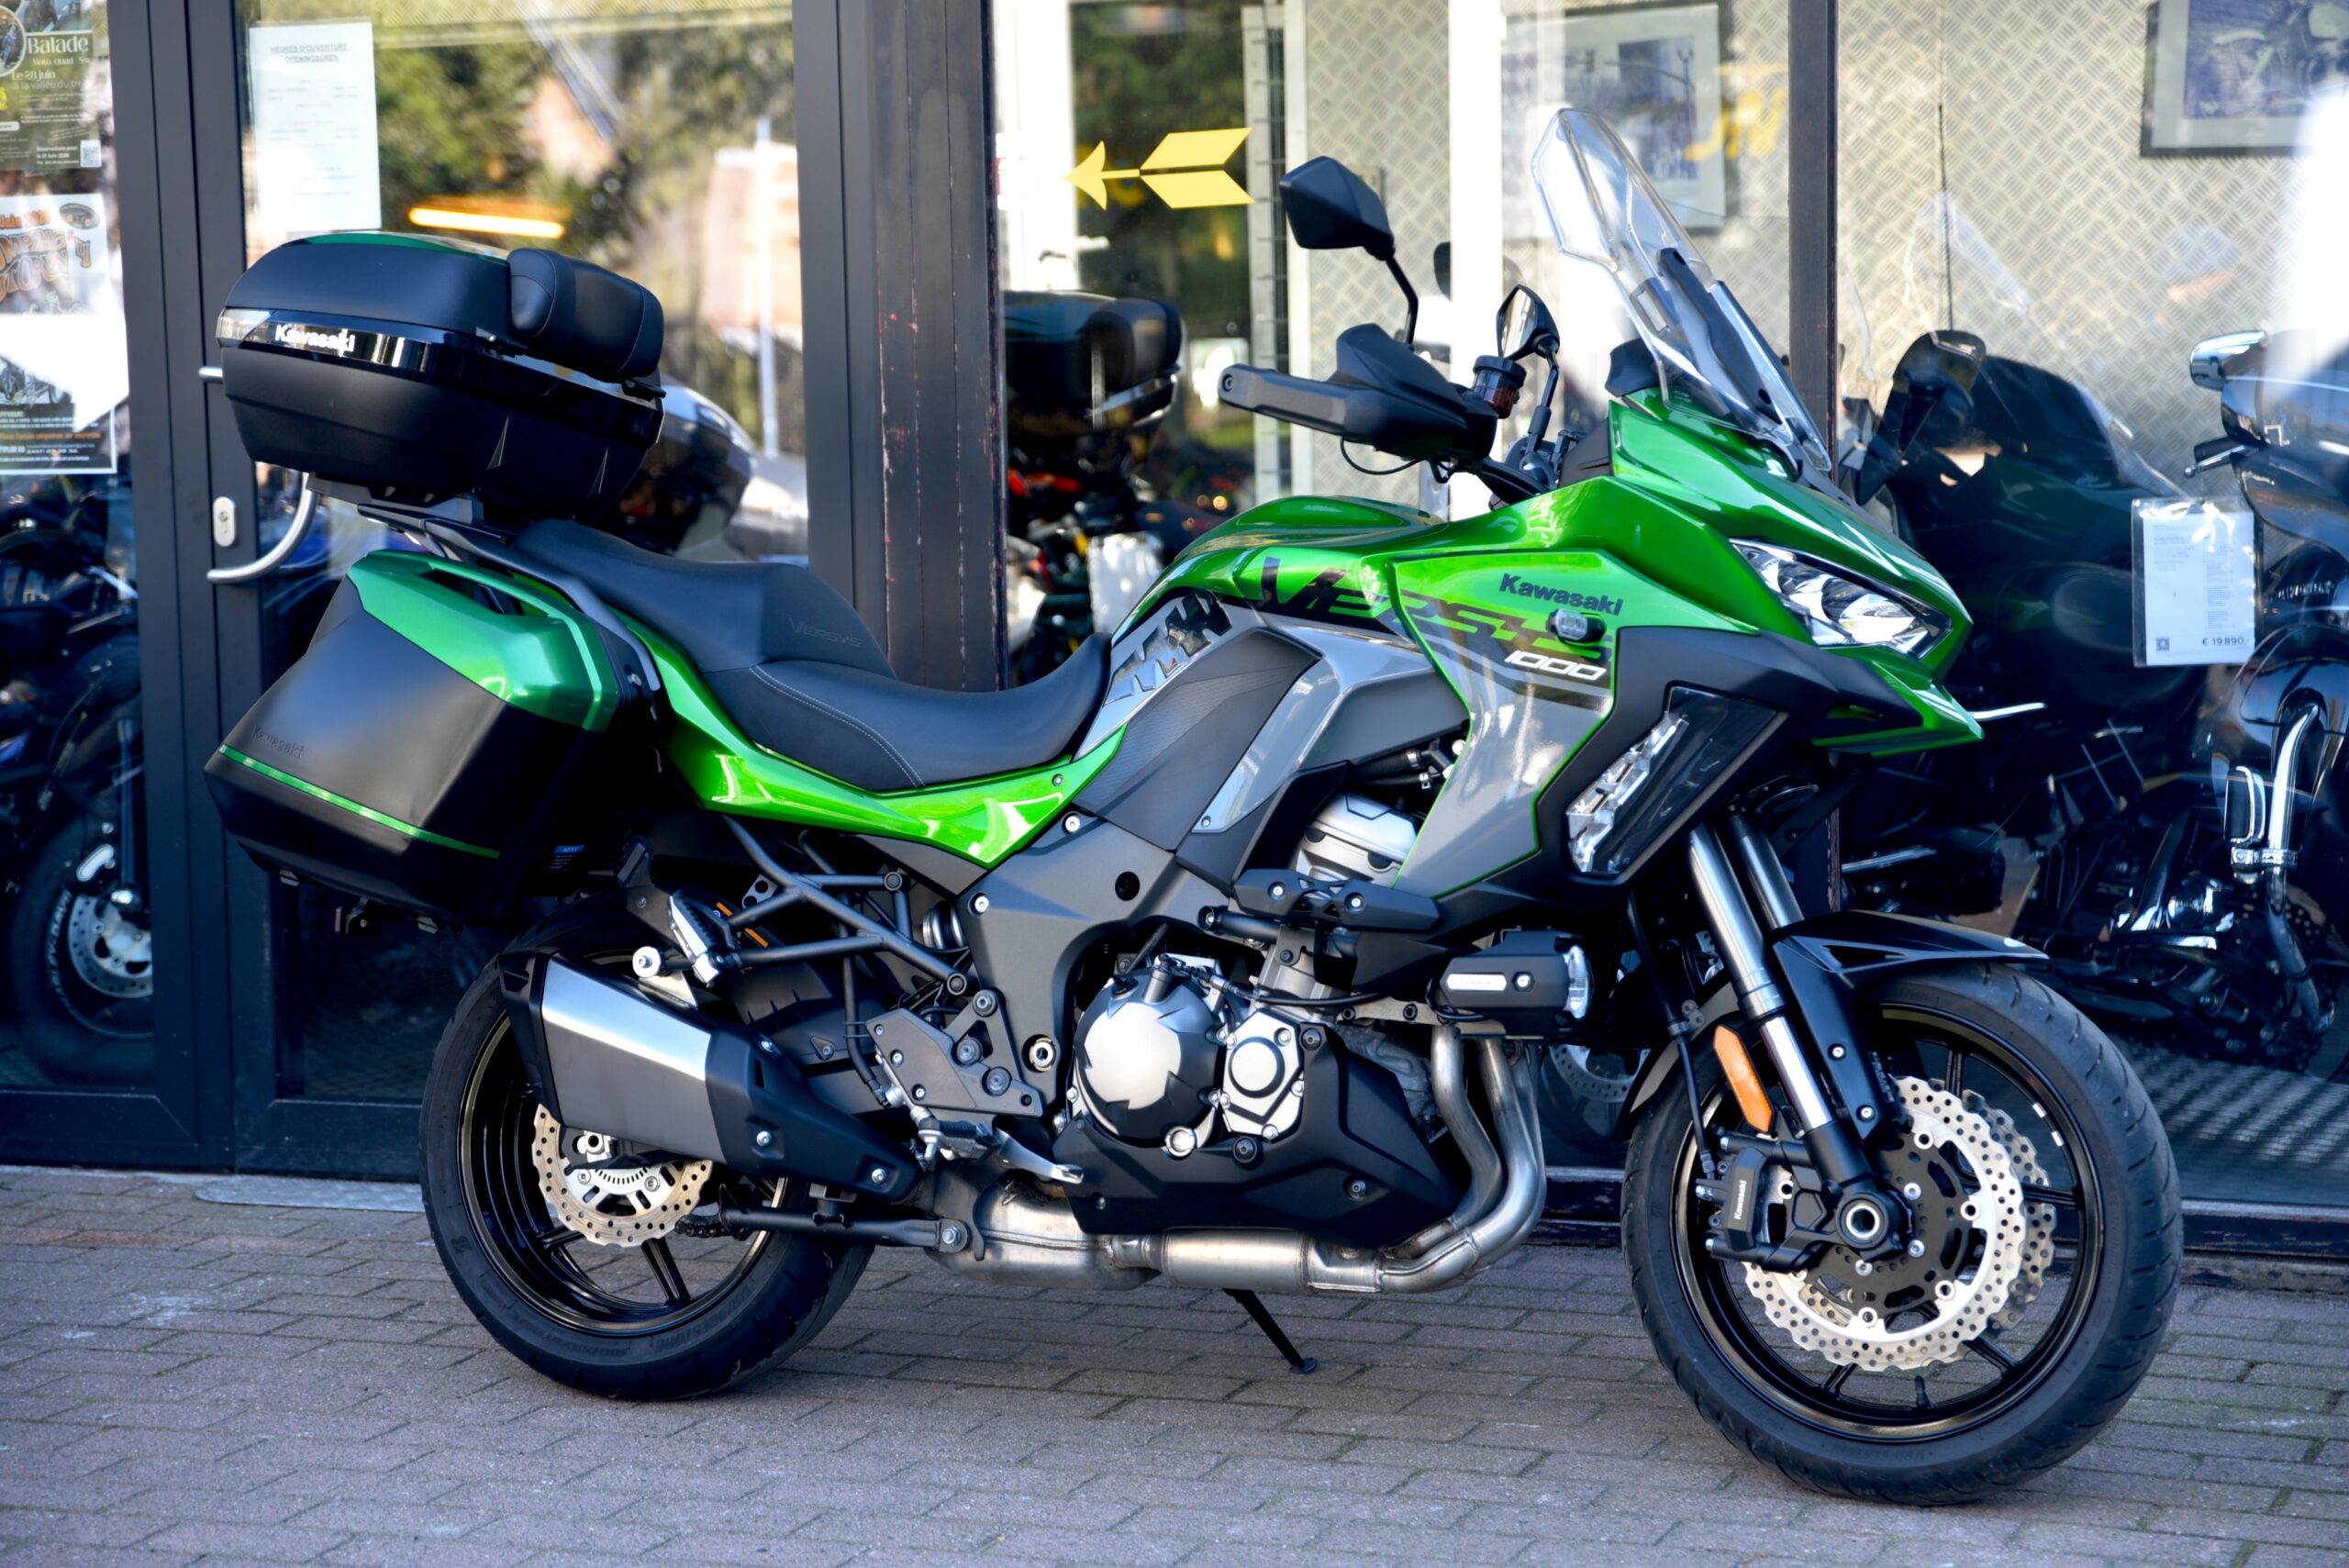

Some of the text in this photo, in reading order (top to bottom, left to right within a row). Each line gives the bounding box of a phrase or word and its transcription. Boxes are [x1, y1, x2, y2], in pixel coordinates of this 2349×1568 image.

[28, 36, 89, 54] Balade
[274, 323, 356, 353] Kawasaki
[1499, 573, 1624, 617] Kawasaki
[787, 616, 862, 648] VERSYS
[1505, 650, 1608, 681] 1000
[250, 726, 306, 760] Kawasaki
[1733, 1179, 1747, 1220] Kawasaki
